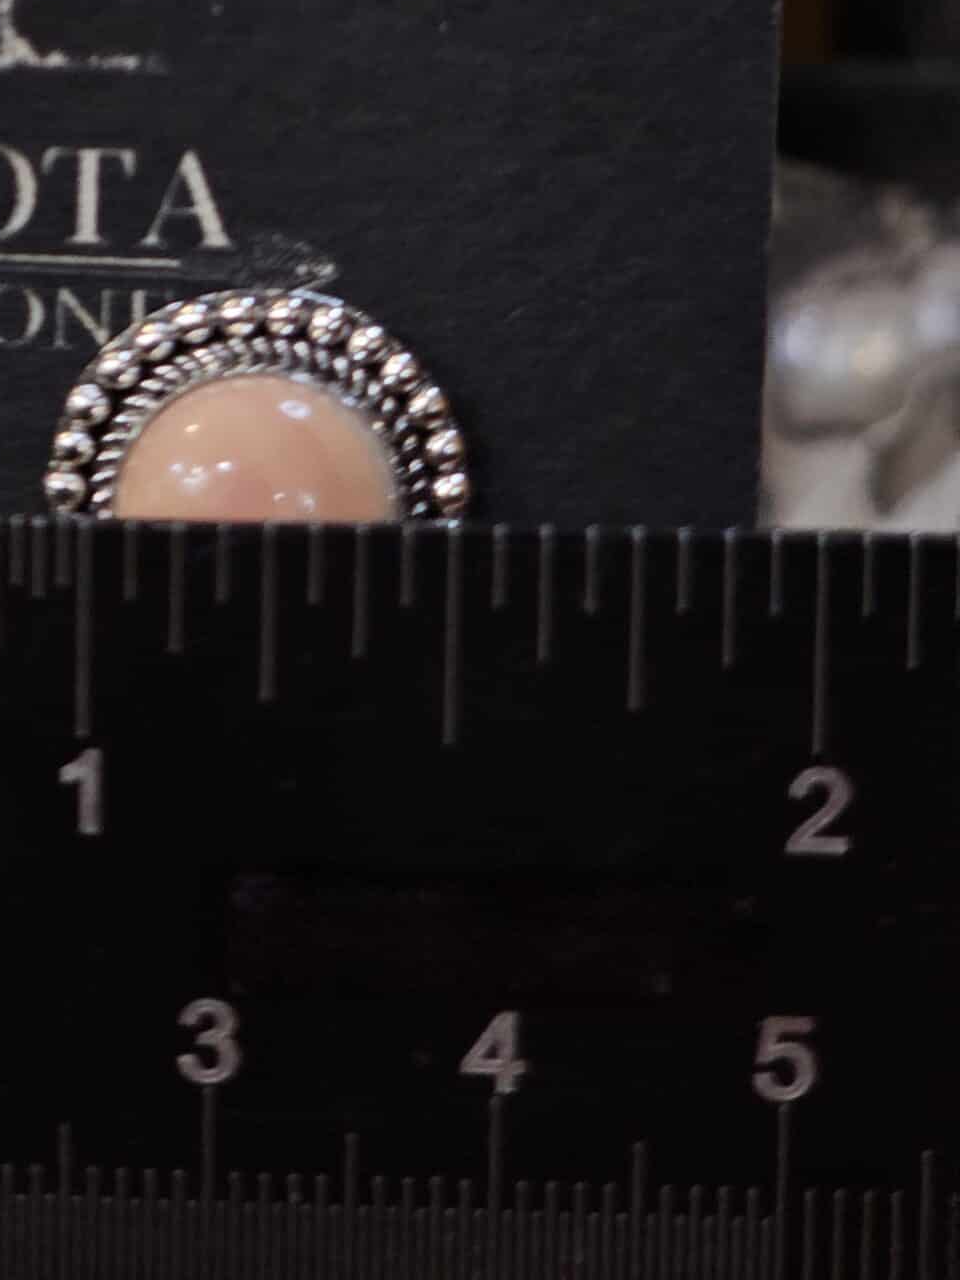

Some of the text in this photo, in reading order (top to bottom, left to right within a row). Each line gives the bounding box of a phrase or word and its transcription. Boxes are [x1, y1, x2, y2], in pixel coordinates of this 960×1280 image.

[59, 747, 853, 857] 1 2
[176, 997, 240, 1086] 3
[459, 1010, 527, 1096] 4
[751, 1014, 819, 1103] 5
